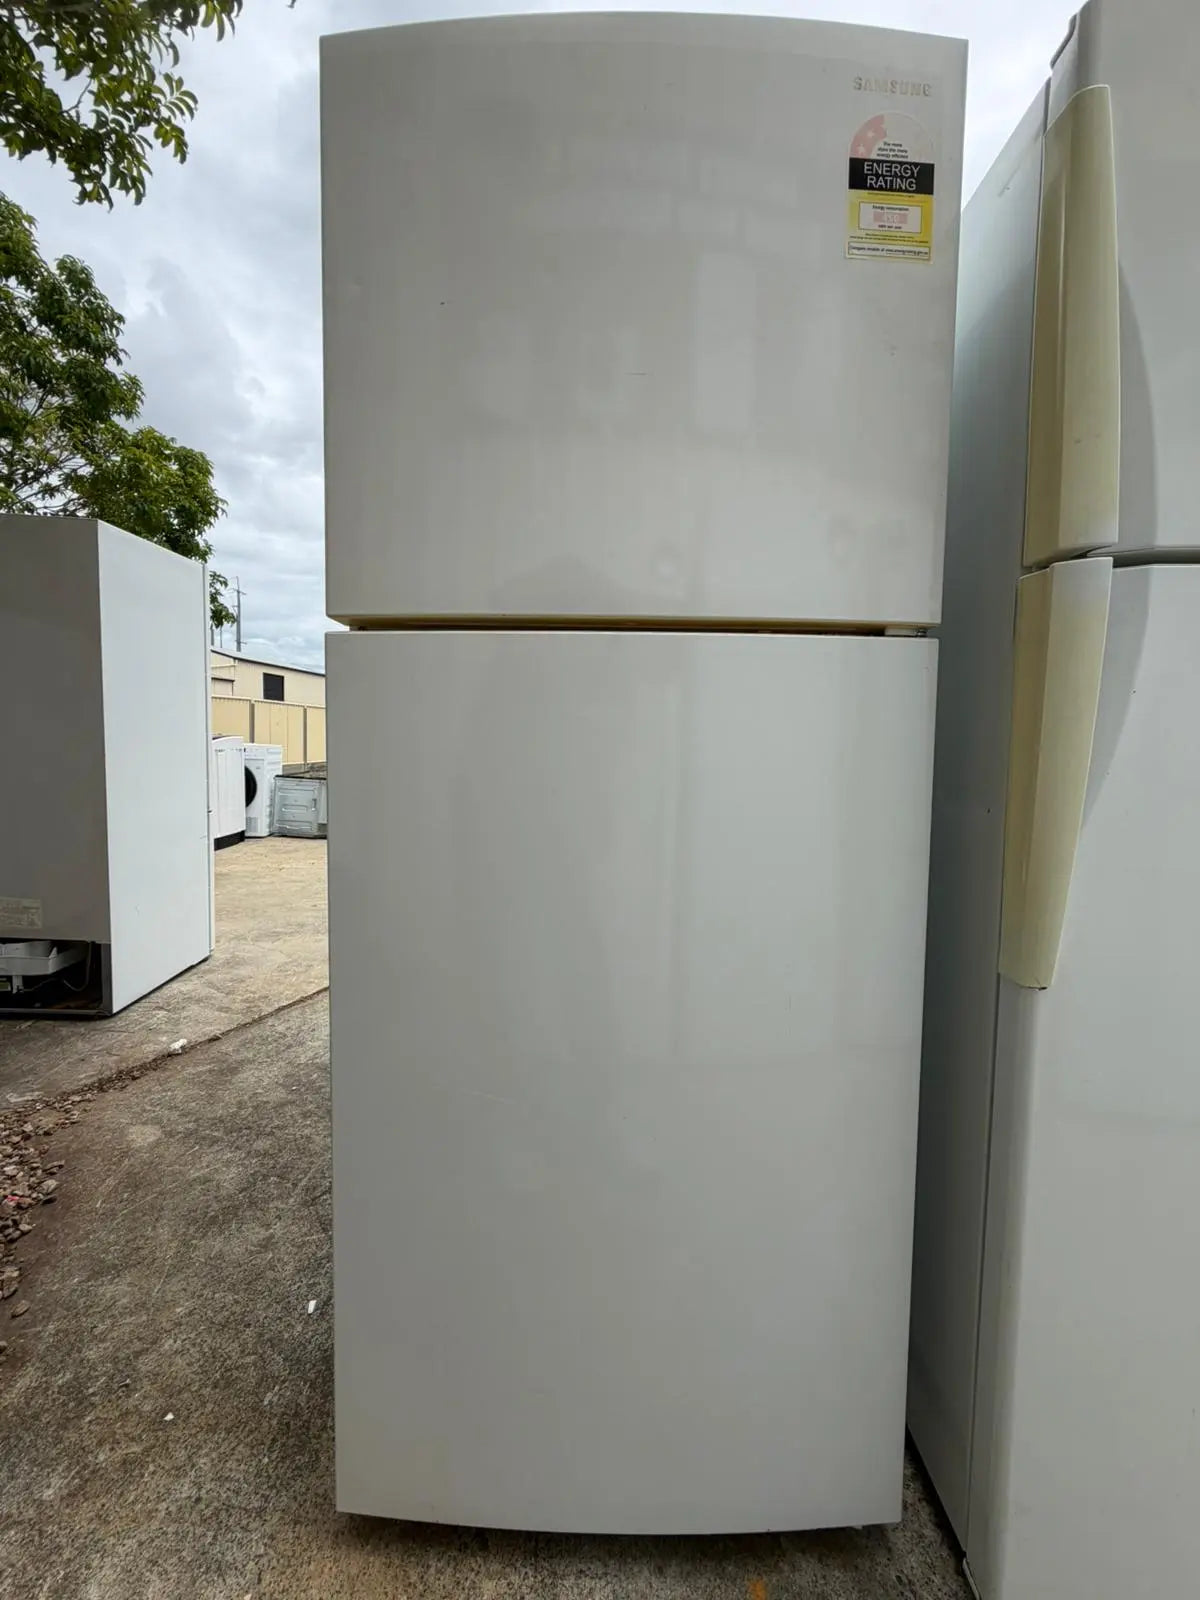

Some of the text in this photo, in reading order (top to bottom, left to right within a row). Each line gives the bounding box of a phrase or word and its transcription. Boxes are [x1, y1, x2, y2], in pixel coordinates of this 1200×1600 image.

[853, 76, 932, 97] SAMSUNG
[863, 162, 920, 177] ENERGY
[867, 175, 916, 191] RATING
